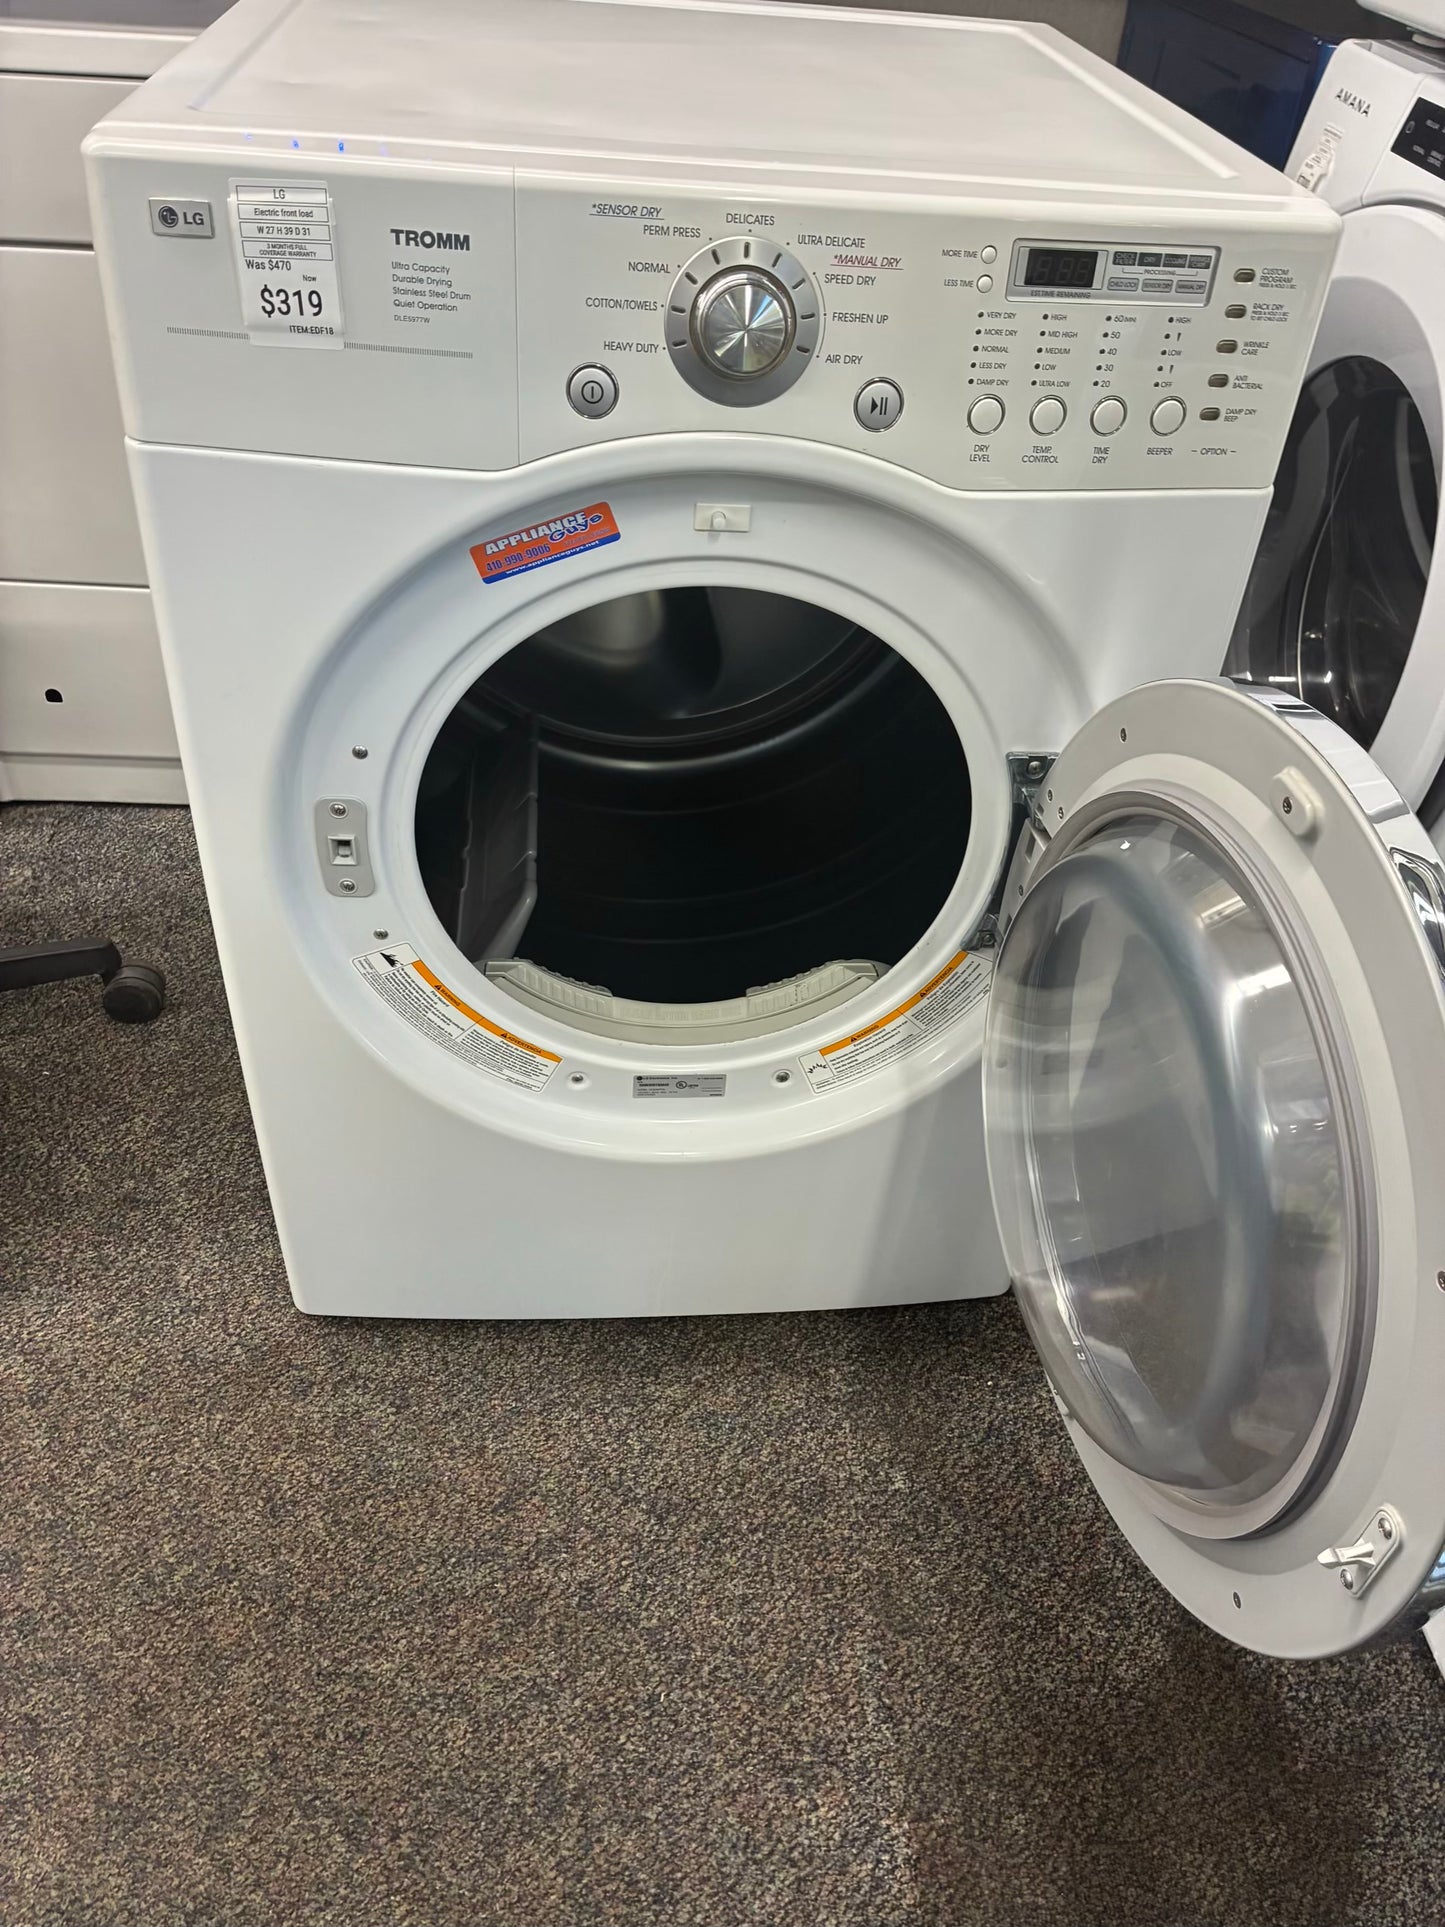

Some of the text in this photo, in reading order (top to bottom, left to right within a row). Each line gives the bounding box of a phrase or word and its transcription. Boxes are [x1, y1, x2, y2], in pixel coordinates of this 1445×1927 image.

[1335, 88, 1371, 117] AMANA
[272, 189, 286, 200] LG
[254, 208, 314, 218] Electric front load
[640, 206, 662, 218] DRY
[183, 212, 204, 226] LG
[726, 213, 775, 226] DELICATES
[256, 226, 310, 236] W 27 H 39 D 31
[643, 224, 701, 238] PERM PRESS
[390, 228, 470, 251] TROMM
[797, 234, 866, 248] ULTRA DELICATE
[942, 249, 978, 258] MORE TIME
[245, 259, 292, 271] Was $470
[628, 261, 672, 274] NORMAL
[880, 257, 902, 268] DRY
[392, 261, 450, 275] Ultra Capacity
[1262, 268, 1289, 276] CUSTOM
[392, 274, 452, 288] Durable Drying
[824, 274, 877, 286] SPEED DRY
[960, 280, 974, 288] TIME
[1260, 276, 1294, 284] PROGRAM
[392, 286, 472, 300] Stainless Steel Drum
[1056, 290, 1092, 298] REMAINING
[260, 284, 323, 318] $319
[393, 298, 458, 312] Quiet Operation
[585, 297, 658, 312] COTTON/TOWELS
[832, 312, 889, 324] FRESHEN UP
[1003, 312, 1016, 320] DRY
[289, 325, 334, 336] ITEM:EDF18
[984, 328, 1004, 336] MORE
[1048, 330, 1060, 338] MID
[1110, 331, 1120, 339] 50
[603, 341, 660, 354] HEAVY DUTY
[981, 346, 1009, 354] NORMAL
[1107, 348, 1117, 356] 40
[1241, 348, 1258, 356] CARE
[825, 354, 864, 365] AIR DRY
[979, 362, 1006, 370] LESS DRY
[1104, 364, 1114, 372] 30
[976, 378, 996, 386] DAMP
[1056, 380, 1070, 388] LOW
[1100, 380, 1110, 388] 20
[1232, 382, 1263, 390] BACTERIAL
[1244, 408, 1257, 416] DRY
[974, 444, 990, 452] DRY
[1093, 446, 1110, 455] TIME
[1146, 447, 1174, 456] BEEPER
[1200, 448, 1228, 456] OPTION
[970, 454, 990, 462] LEVEL
[1022, 454, 1059, 464] CONTROL
[1092, 456, 1108, 464] DRY
[485, 511, 586, 555] APPLIANCE
[549, 513, 604, 543] Guys
[486, 543, 550, 572] 410-990-9006
